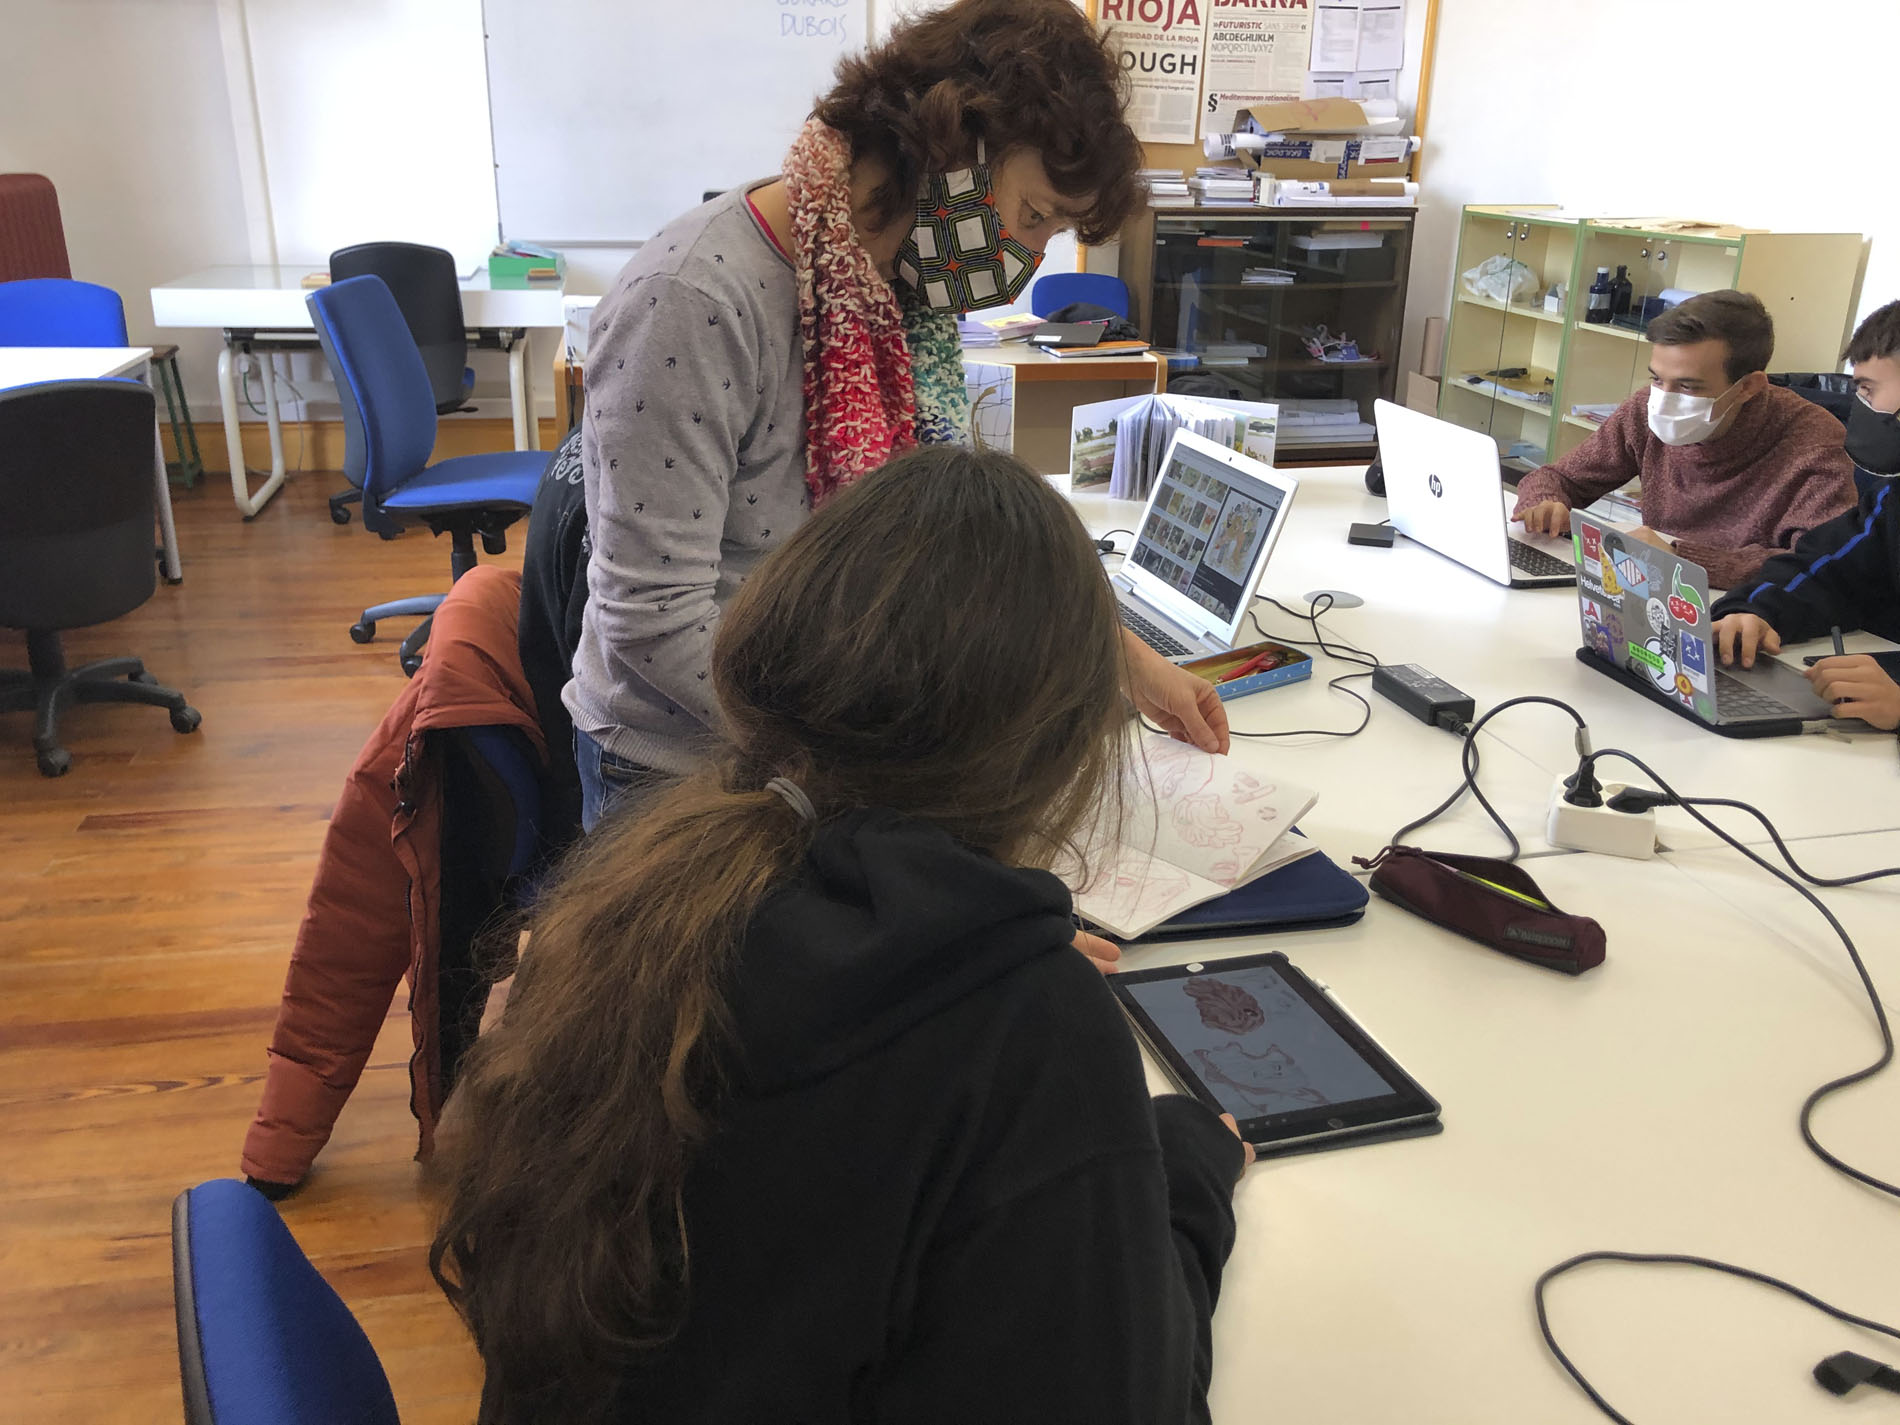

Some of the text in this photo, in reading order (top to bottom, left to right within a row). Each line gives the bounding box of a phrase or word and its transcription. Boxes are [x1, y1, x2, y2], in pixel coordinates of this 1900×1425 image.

[781, 13, 847, 44] DUBOIS
[1102, 0, 1201, 32] RIOJA
[1153, 33, 1165, 41] DE
[1178, 36, 1200, 44] RIOJA
[1429, 473, 1443, 498] hp
